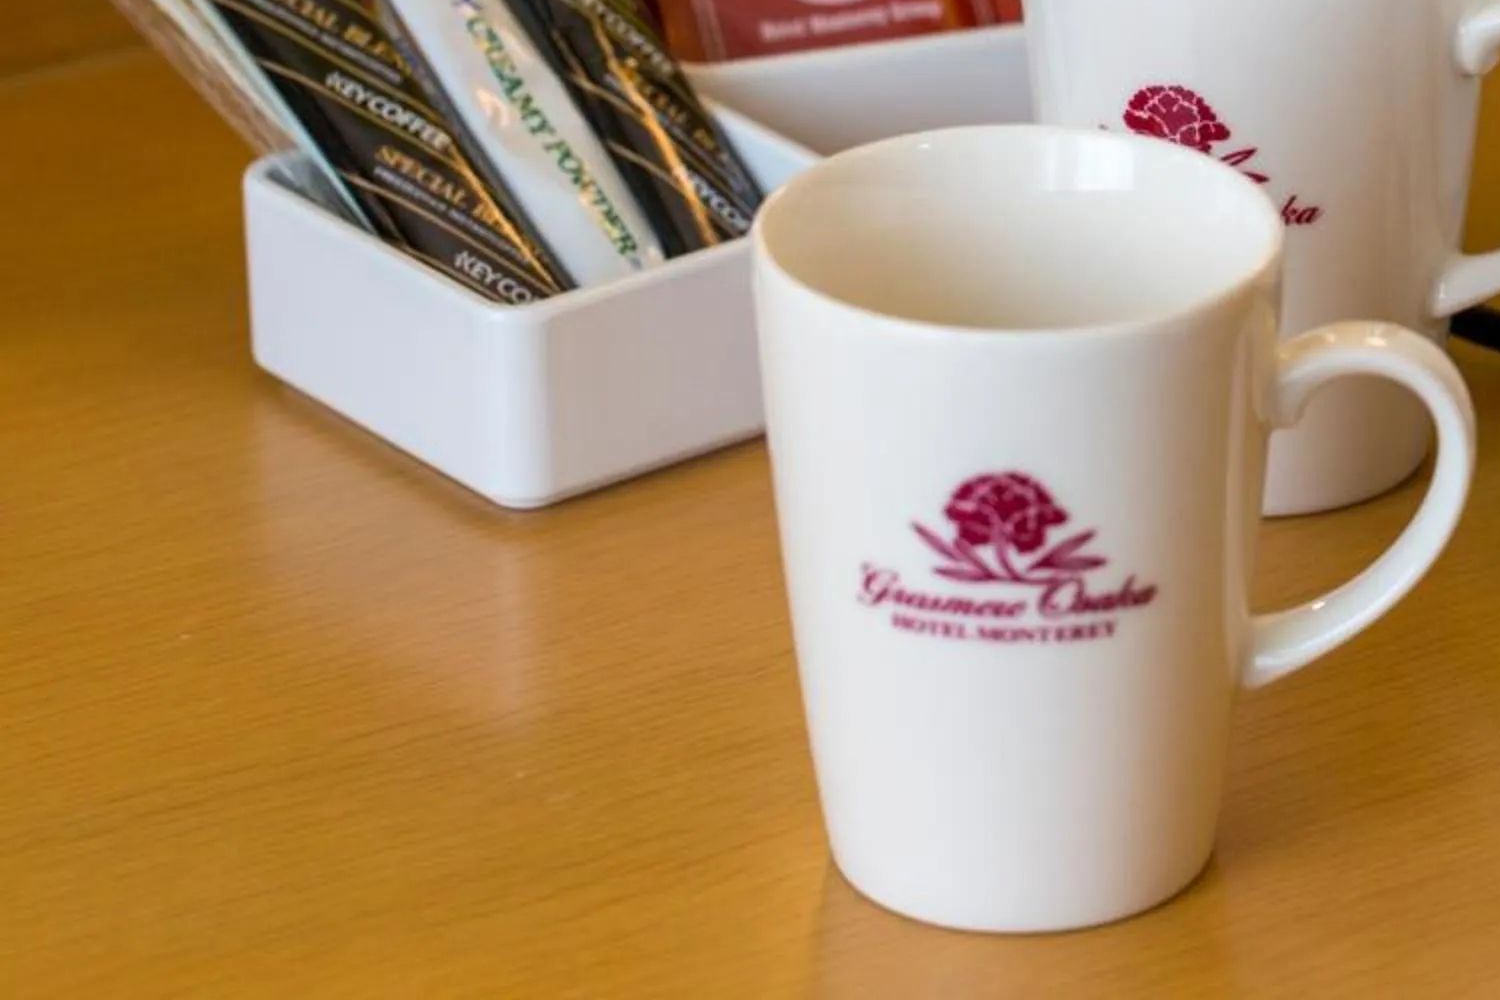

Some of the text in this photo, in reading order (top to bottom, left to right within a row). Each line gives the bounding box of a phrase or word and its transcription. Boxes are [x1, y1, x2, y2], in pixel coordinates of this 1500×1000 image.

[467, 16, 555, 137] CREAMY
[543, 139, 638, 257] POWDER
[375, 146, 467, 206] SPECIAL
[891, 613, 1116, 642] HOTEL MONTEREY
